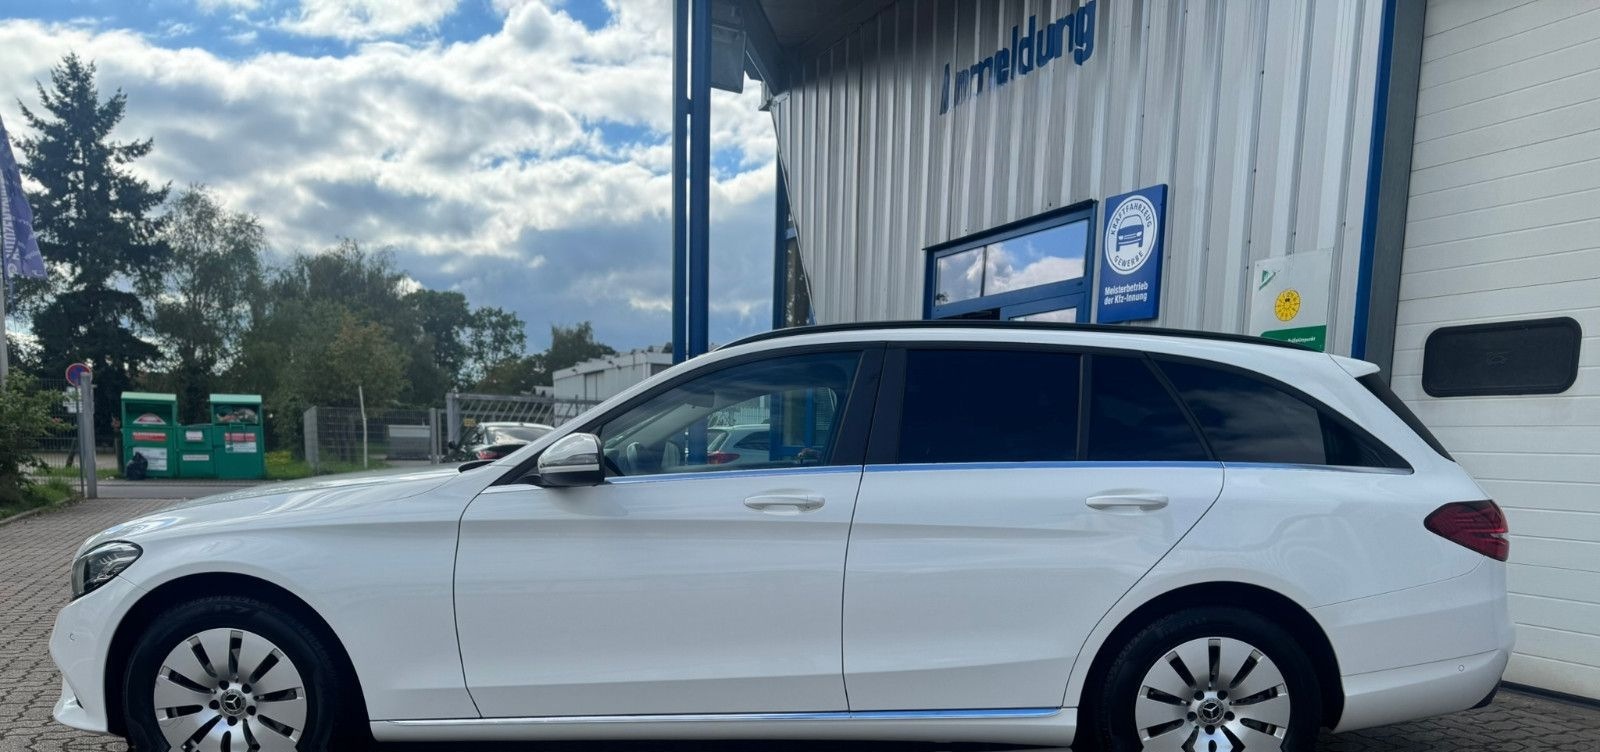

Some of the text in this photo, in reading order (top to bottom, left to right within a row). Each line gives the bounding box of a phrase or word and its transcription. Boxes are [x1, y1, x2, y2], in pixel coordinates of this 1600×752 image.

[1111, 203, 1152, 235] KRAFTFAHRZEUG
[1114, 251, 1144, 267] GEWERBE
[1104, 281, 1148, 295] Meisterbetrieb
[1104, 292, 1147, 305] der Kfz-Innung
